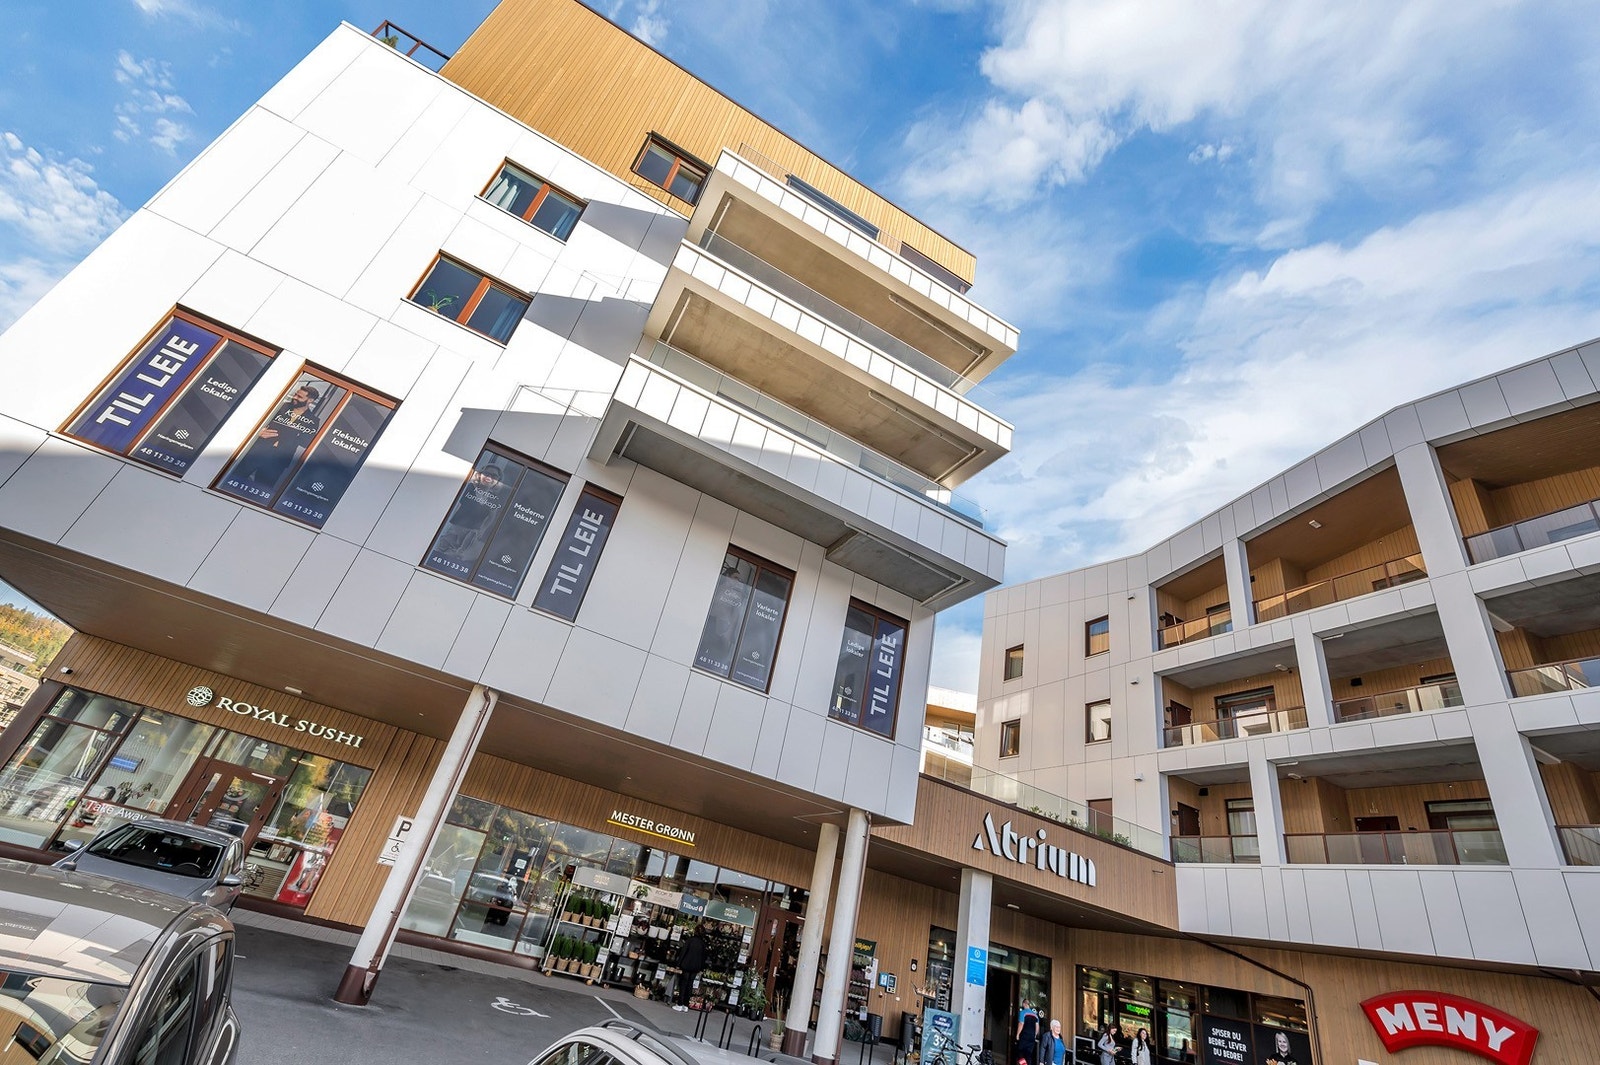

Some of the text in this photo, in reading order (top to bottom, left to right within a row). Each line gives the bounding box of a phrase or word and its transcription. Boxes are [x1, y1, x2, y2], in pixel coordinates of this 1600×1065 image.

[96, 392, 154, 426] TIL
[136, 336, 199, 388] LEIE
[207, 377, 238, 394] Ledige
[200, 384, 232, 401] lokaler
[285, 409, 315, 424] Kontor-
[331, 437, 360, 454] lokaler
[332, 429, 369, 448] Fleksible
[514, 502, 545, 520] Moderne
[514, 511, 538, 526] lokaler
[550, 508, 604, 595] TIL LEIE
[756, 601, 778, 616] Varierte
[756, 610, 776, 622] lokaler
[870, 634, 896, 715] TIL LEIE
[216, 697, 364, 748] ROYAL SUSHI
[85, 800, 148, 820] Take Away
[396, 821, 412, 837] P
[611, 810, 695, 842] MESTER GRØNN
[972, 812, 1096, 887] Atrium
[682, 901, 699, 913] Tilbud
[1211, 1027, 1241, 1040] SPISER DU
[1376, 1002, 1515, 1052] MENY
[1208, 1037, 1247, 1052] BEDRE, LEVER
[1213, 1048, 1244, 1062] DU BEDRE!
